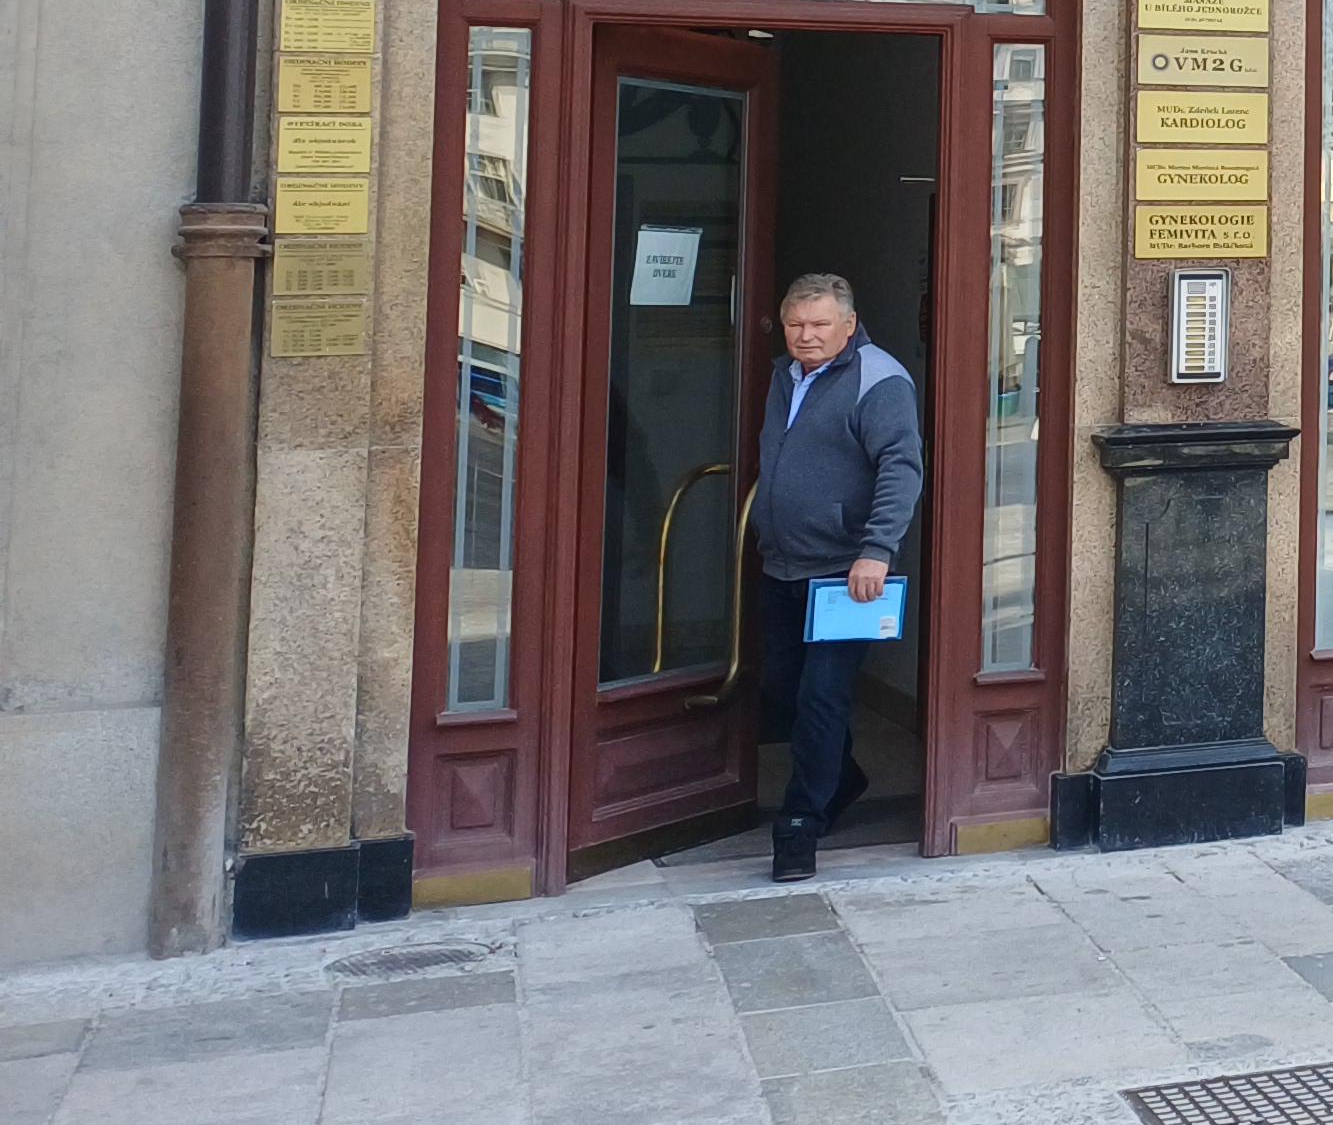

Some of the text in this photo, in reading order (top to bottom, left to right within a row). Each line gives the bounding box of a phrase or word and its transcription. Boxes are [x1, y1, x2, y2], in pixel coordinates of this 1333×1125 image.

[1160, 117, 1247, 130] KARDIOLOG
[1157, 173, 1249, 185] GYNEKOLOG
[1148, 214, 1255, 226] GYNEKOLOGIE
[1148, 228, 1217, 240] FEMIVITA
